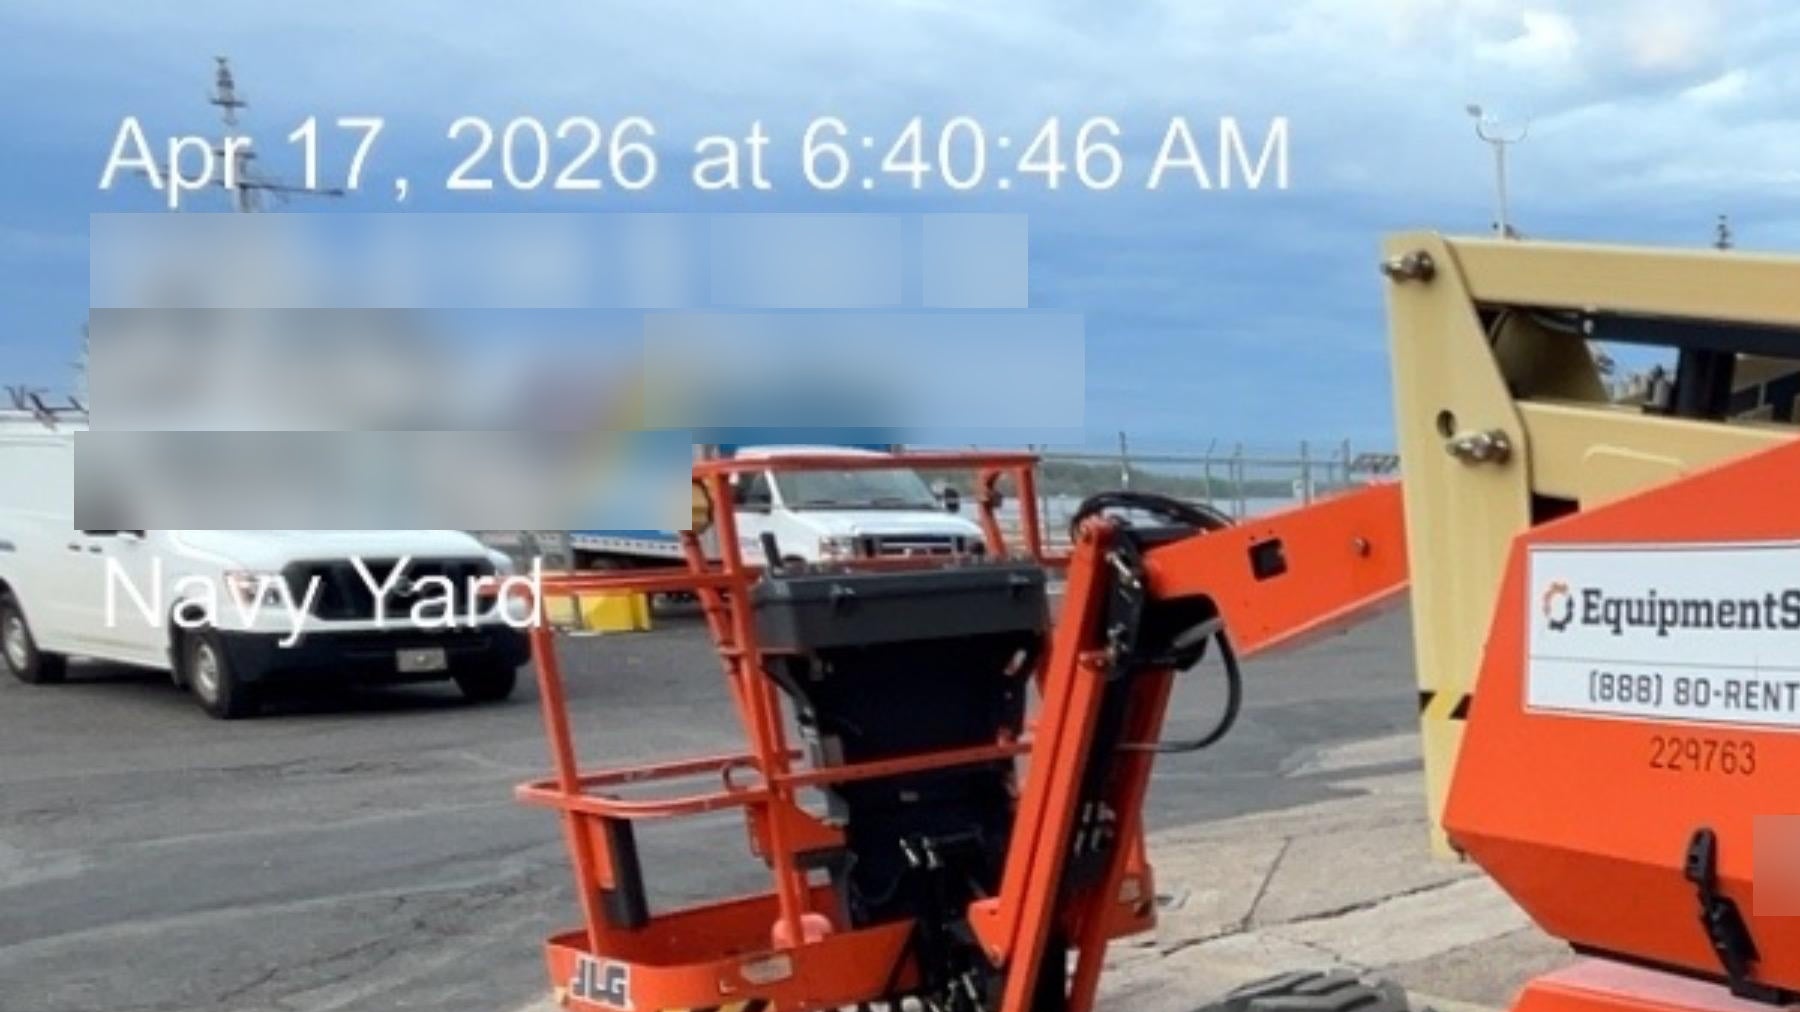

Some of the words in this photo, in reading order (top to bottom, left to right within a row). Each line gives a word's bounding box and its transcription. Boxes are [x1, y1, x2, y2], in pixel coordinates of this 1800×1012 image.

[1589, 670, 1663, 708] (888)
[1649, 735, 1757, 776] 229763
[572, 959, 627, 1008] JLG
